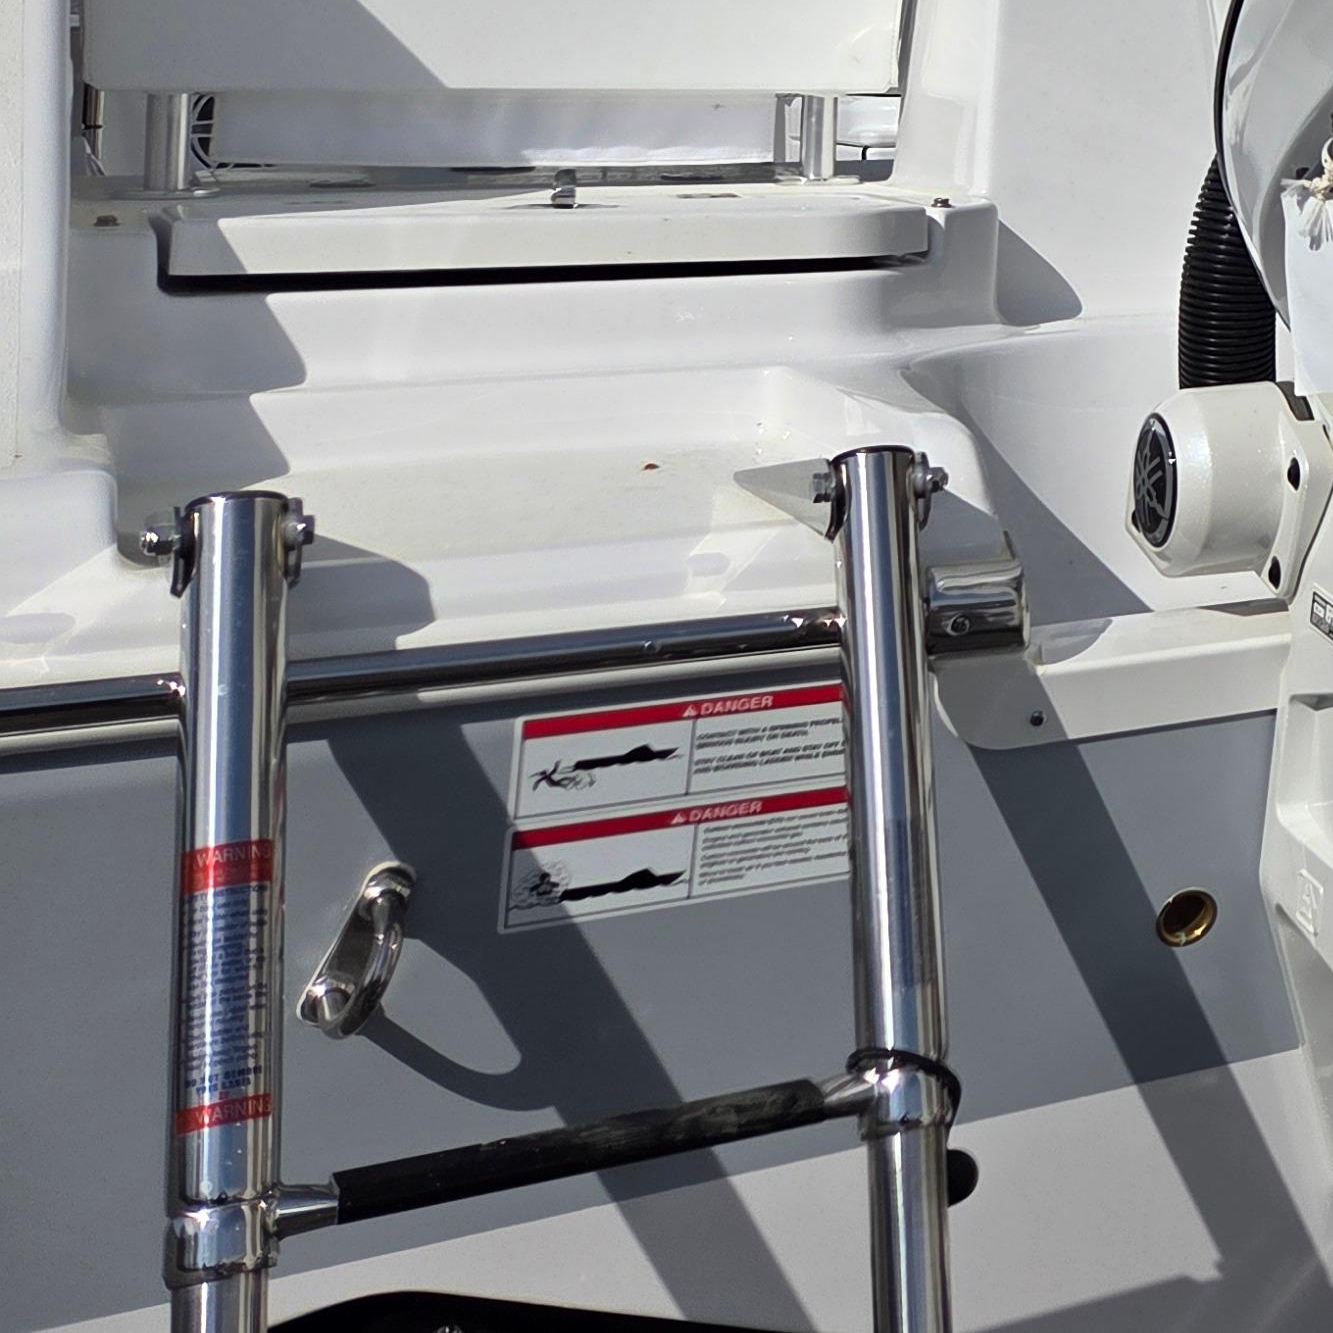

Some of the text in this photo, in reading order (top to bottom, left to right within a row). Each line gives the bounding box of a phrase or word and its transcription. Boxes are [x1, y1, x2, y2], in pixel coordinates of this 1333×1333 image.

[700, 695, 774, 715] DANGER
[689, 800, 763, 822] DANGER
[196, 844, 272, 868] WARNING
[195, 1097, 272, 1124] WARNING
